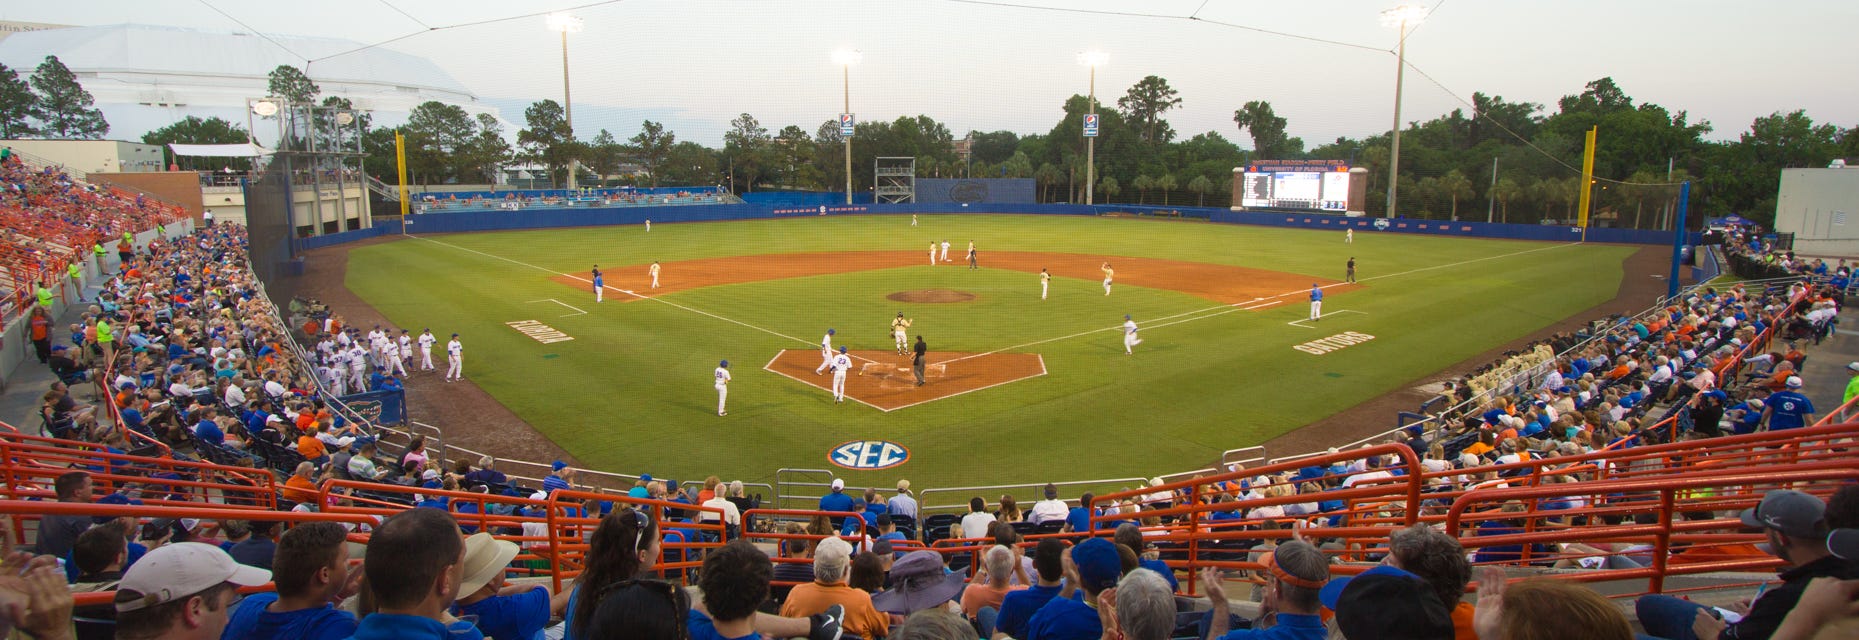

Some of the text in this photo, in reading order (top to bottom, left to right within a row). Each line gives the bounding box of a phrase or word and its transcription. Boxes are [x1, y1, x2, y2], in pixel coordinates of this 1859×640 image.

[1292, 331, 1376, 355] GATORS
[838, 357, 847, 365] 23
[835, 440, 904, 467] SEC
